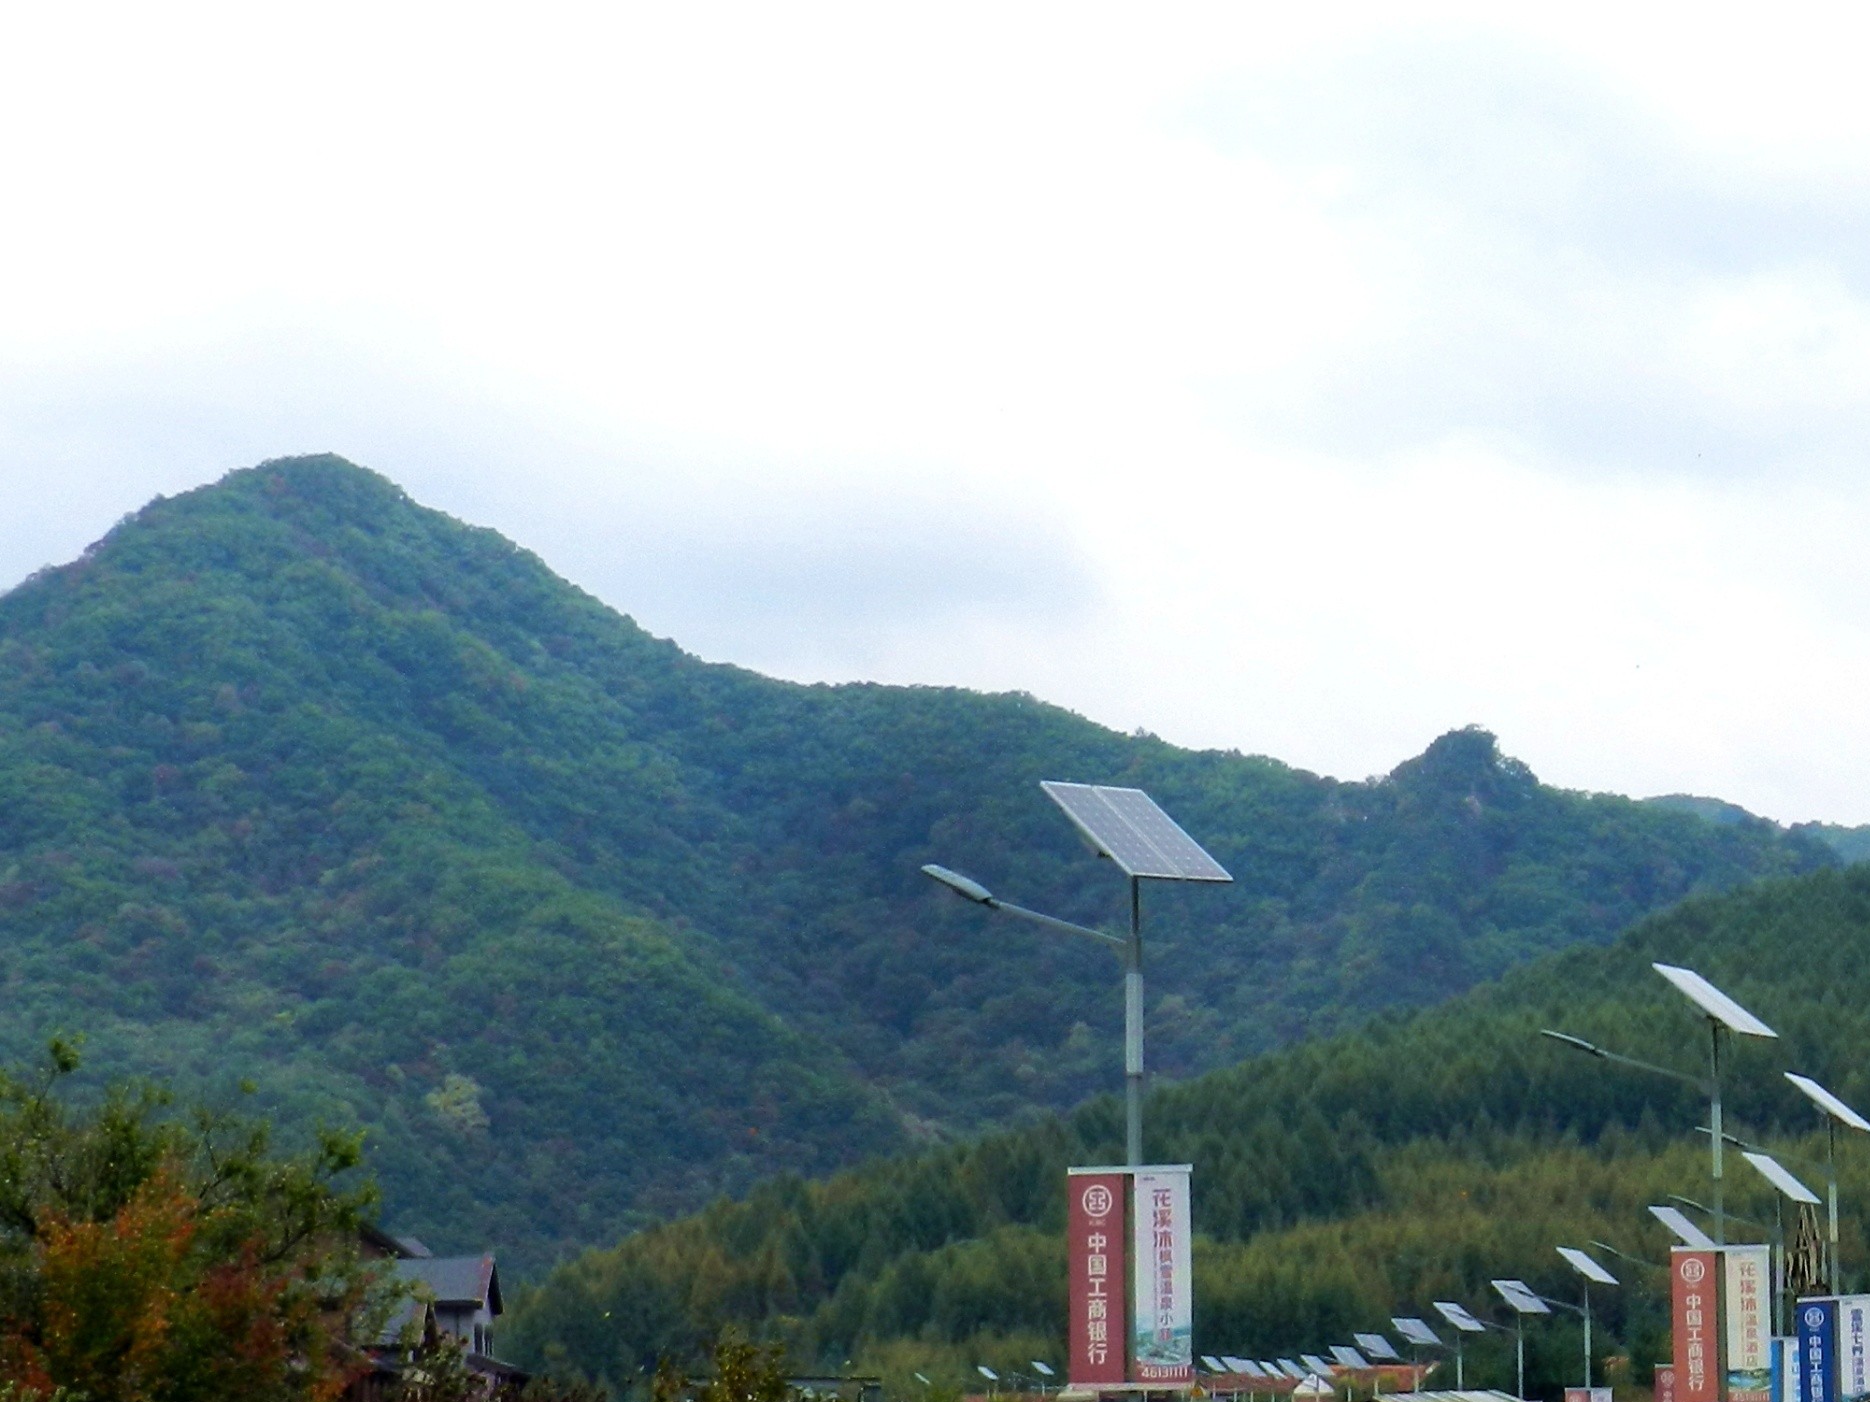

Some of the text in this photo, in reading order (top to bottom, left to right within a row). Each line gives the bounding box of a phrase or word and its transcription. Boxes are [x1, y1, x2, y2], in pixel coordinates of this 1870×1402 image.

[1087, 1232, 1108, 1365] 中国工商银行
[1686, 1293, 1705, 1391] 中国工商银行
